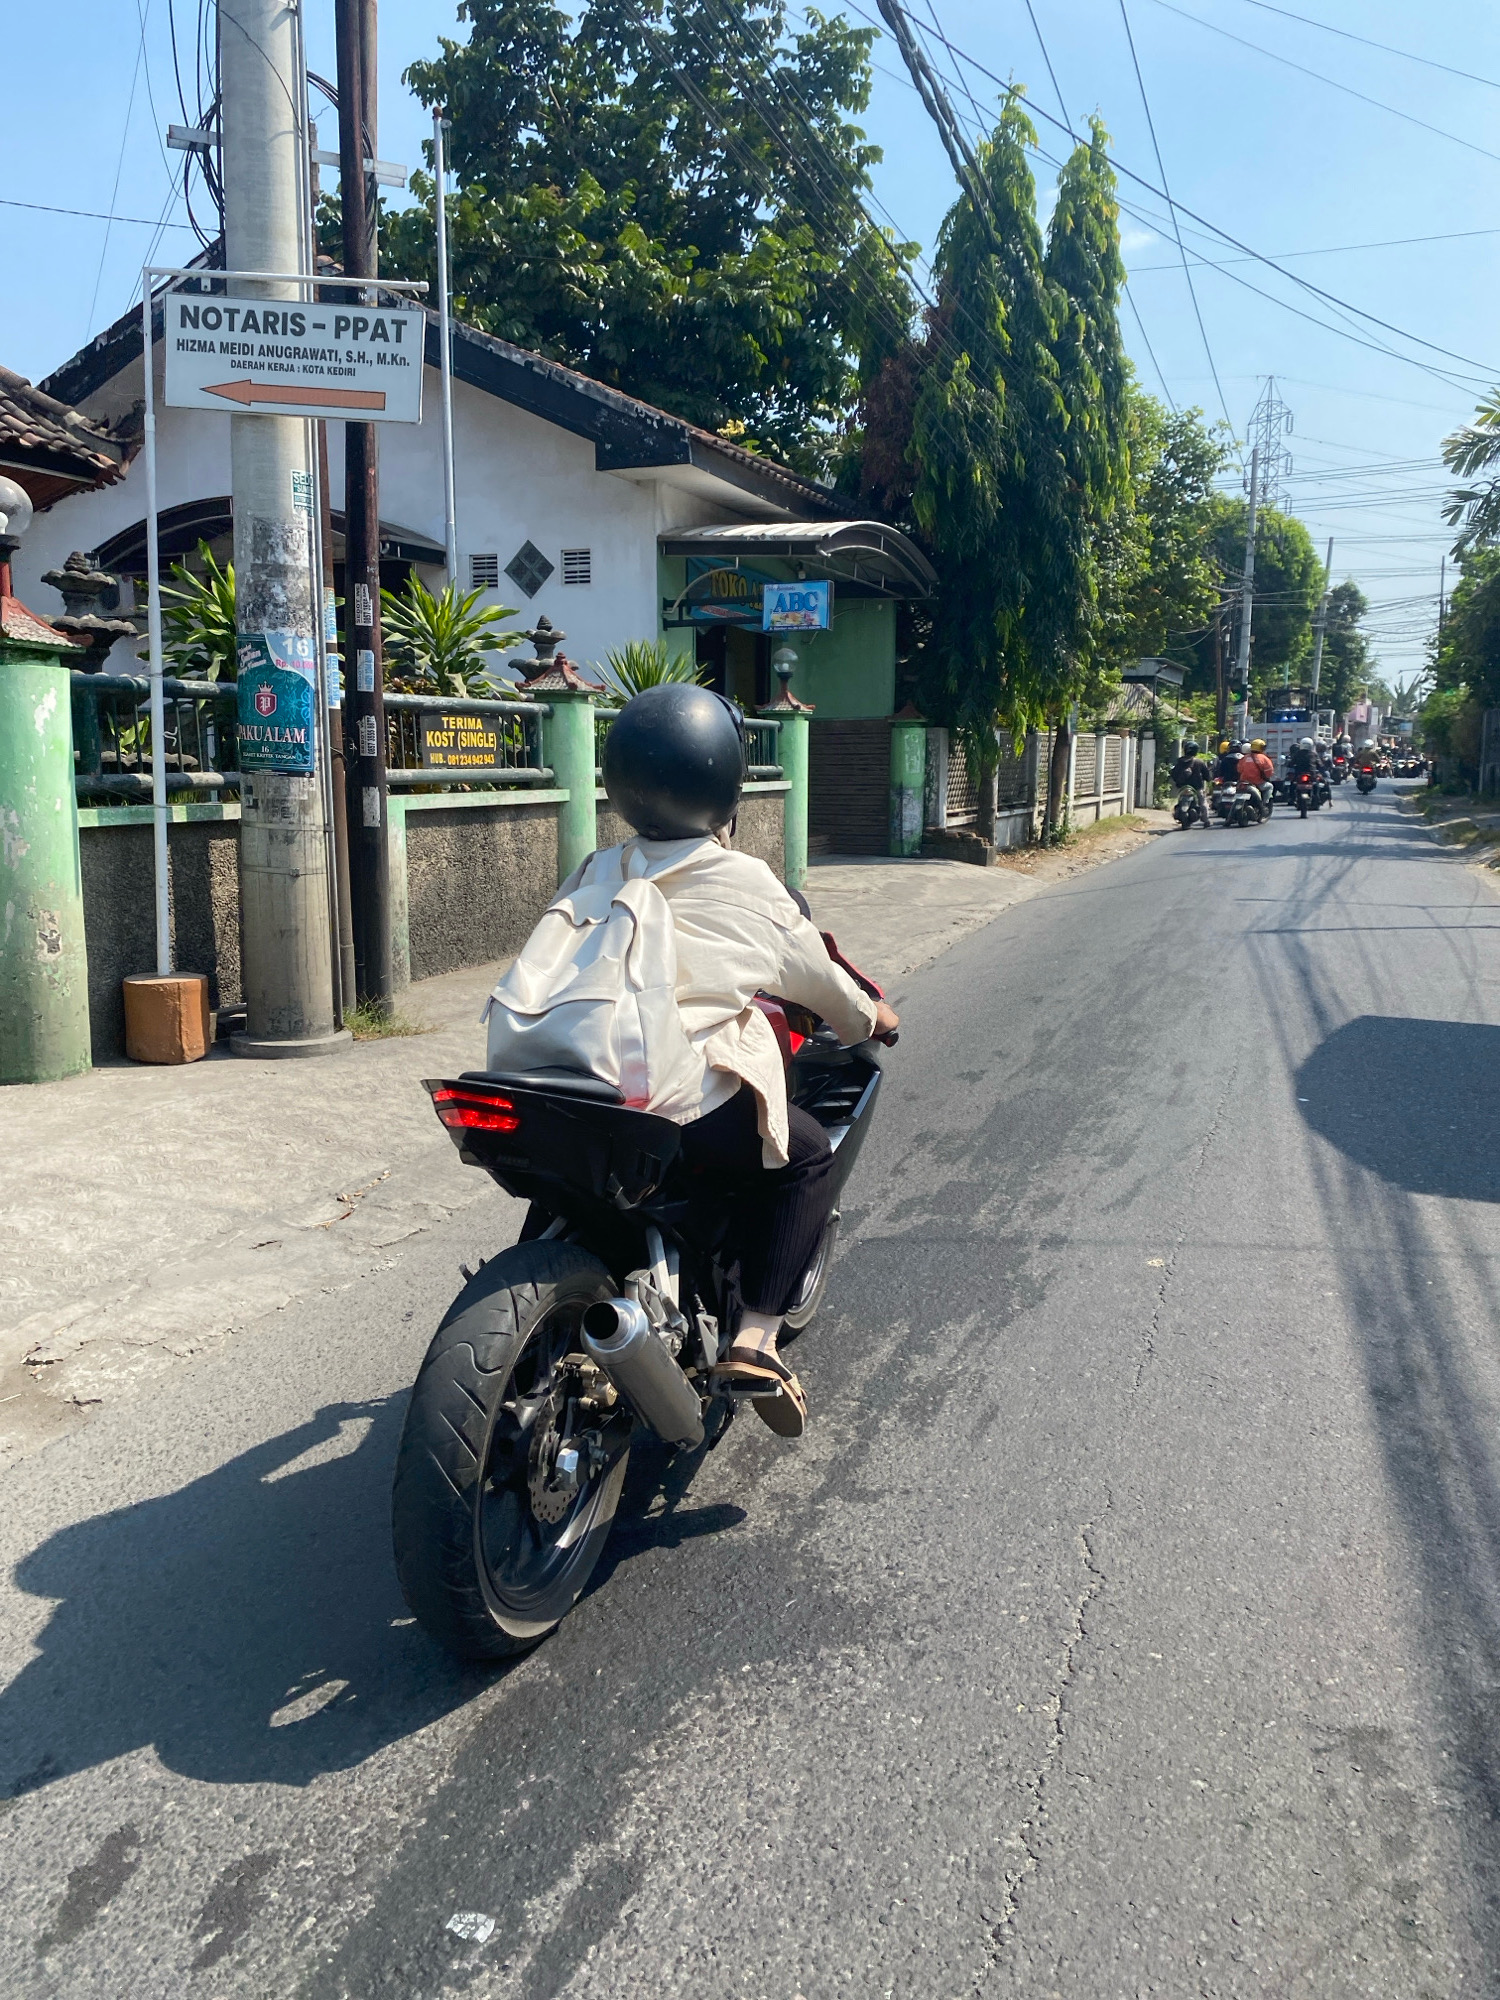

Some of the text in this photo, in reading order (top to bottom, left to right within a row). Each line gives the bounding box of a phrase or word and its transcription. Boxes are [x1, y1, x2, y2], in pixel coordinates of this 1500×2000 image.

[180, 304, 306, 337] NOTARIS
[334, 315, 408, 344] PPAT
[176, 338, 410, 367] HIZMA MEIDI ANUGRAWATI, S.H., M.Kn.
[230, 359, 265, 371] DAERAH
[267, 362, 295, 373] KERJA
[302, 364, 325, 375] KOTA
[327, 366, 356, 377] KEDIRI
[710, 569, 748, 600] TOKO
[773, 591, 818, 612] ABC
[282, 637, 309, 657] 16
[275, 659, 289, 668] Rp.
[441, 716, 483, 730] TERIMA
[261, 745, 270, 753] 16
[426, 731, 497, 751] KOST (SINGLE)
[430, 752, 446, 764] HUB.
